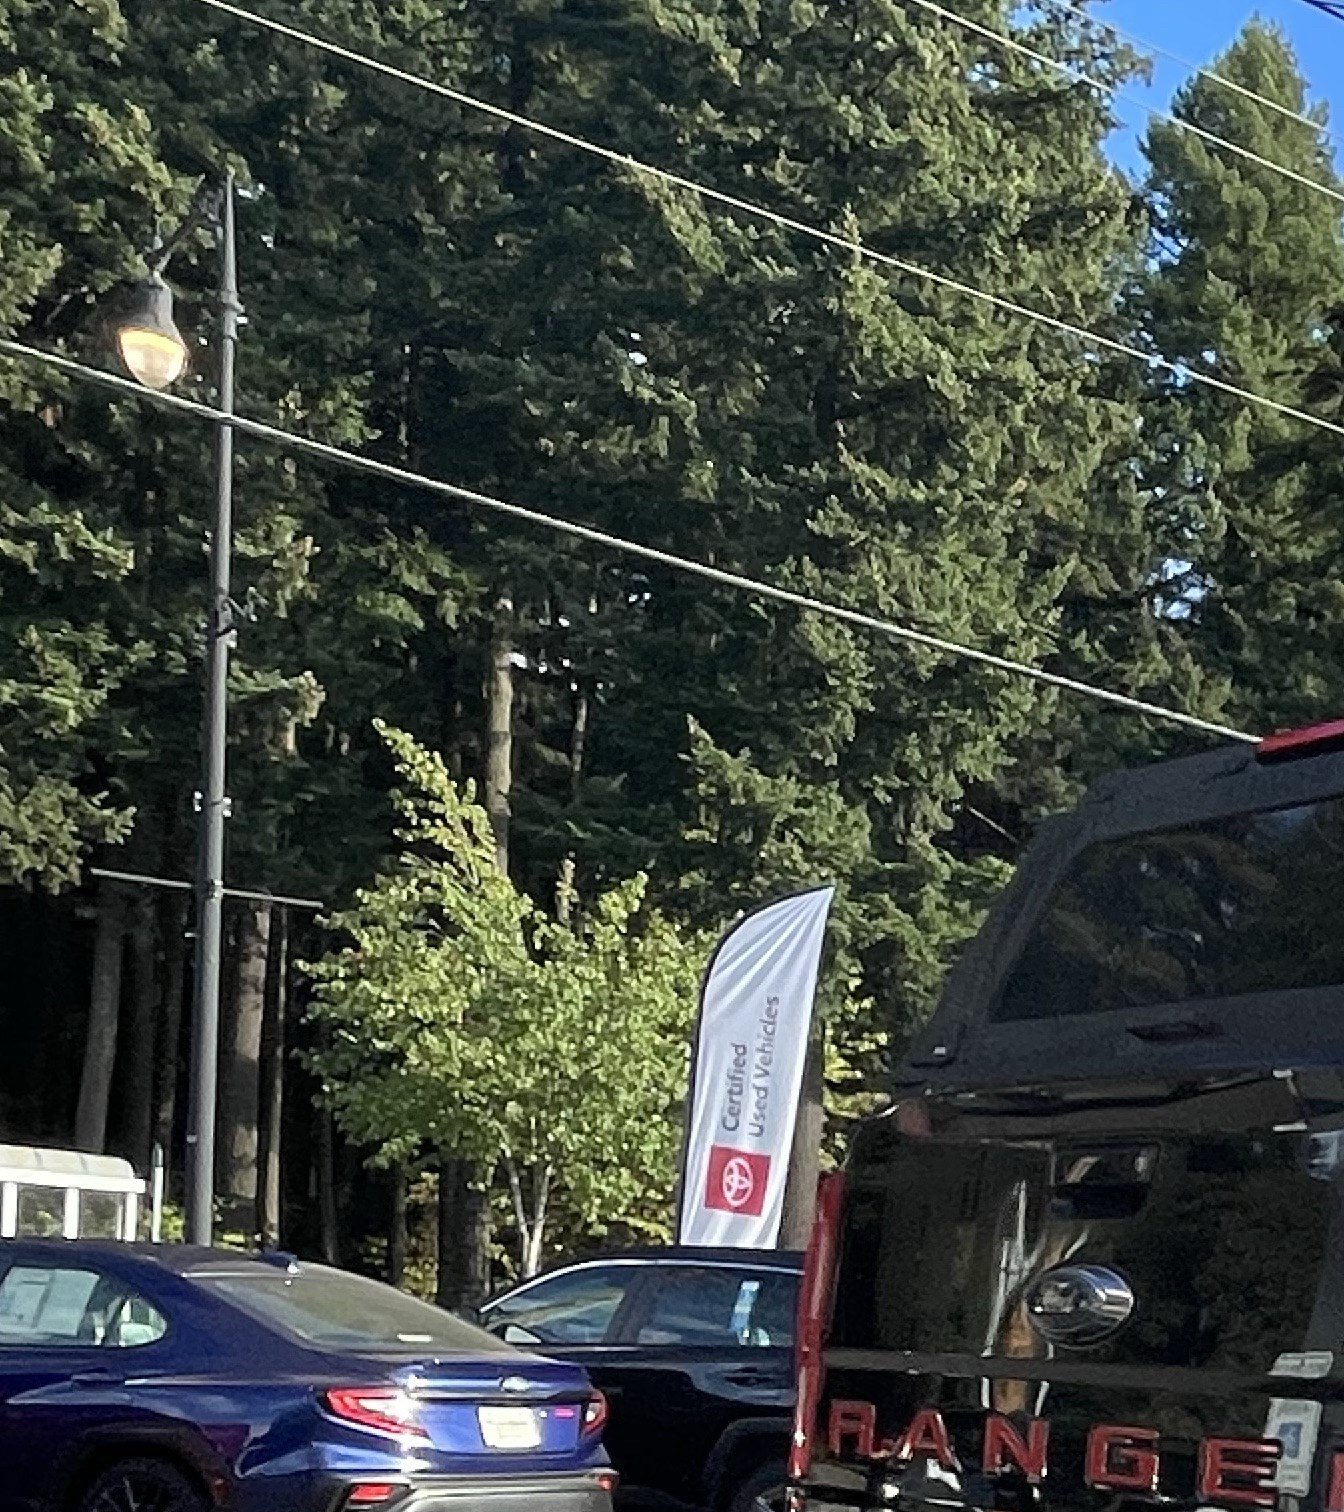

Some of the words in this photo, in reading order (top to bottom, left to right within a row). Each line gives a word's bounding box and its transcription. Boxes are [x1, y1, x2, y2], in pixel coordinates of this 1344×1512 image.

[753, 996, 779, 1080] Vehicles
[722, 1042, 747, 1132] Certified
[749, 1083, 769, 1138] Used
